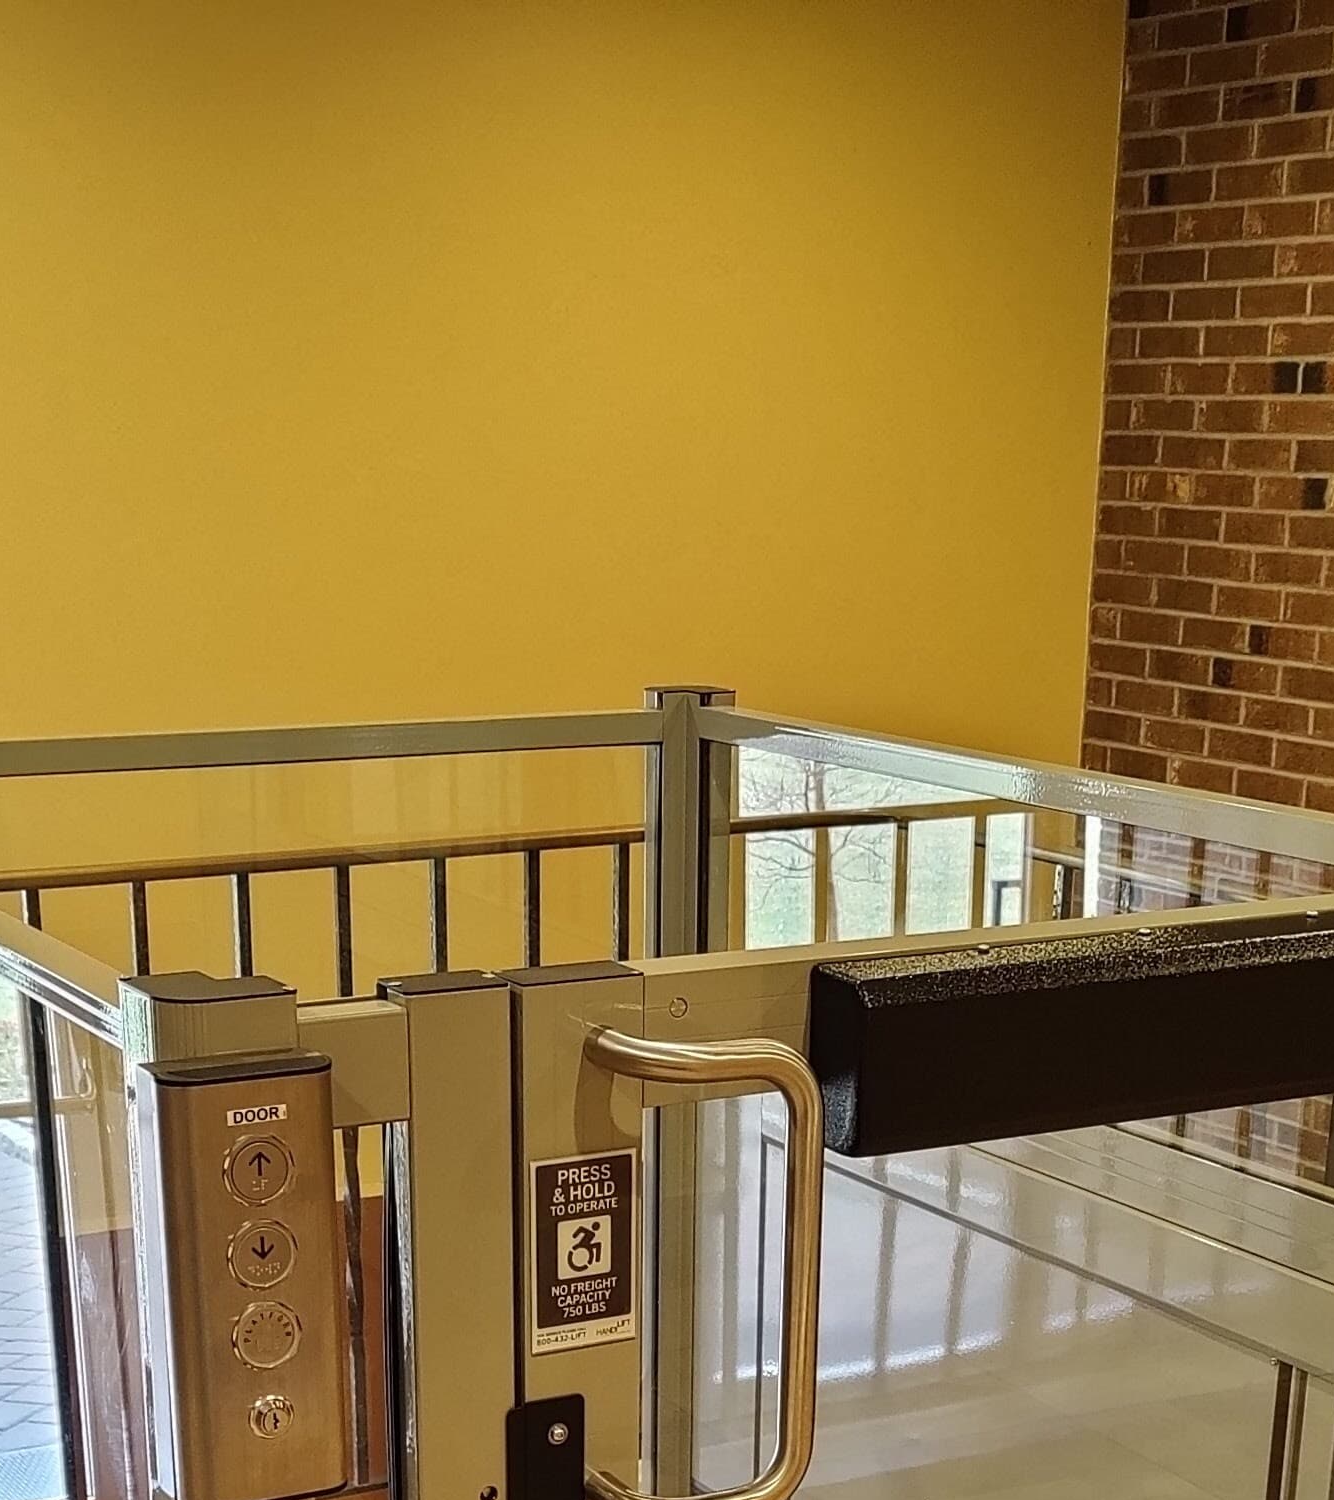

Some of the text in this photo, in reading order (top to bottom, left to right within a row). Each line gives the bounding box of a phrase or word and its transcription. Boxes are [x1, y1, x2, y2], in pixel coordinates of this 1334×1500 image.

[233, 1106, 280, 1124] DOOR
[557, 1164, 611, 1185] PRESS
[553, 1181, 615, 1203] & HOLD
[550, 1197, 618, 1216] TO OPERATE
[551, 1276, 617, 1297] NO FREIGHT
[557, 1289, 611, 1307] CAPACITY
[563, 1301, 606, 1318] 750 LBS
